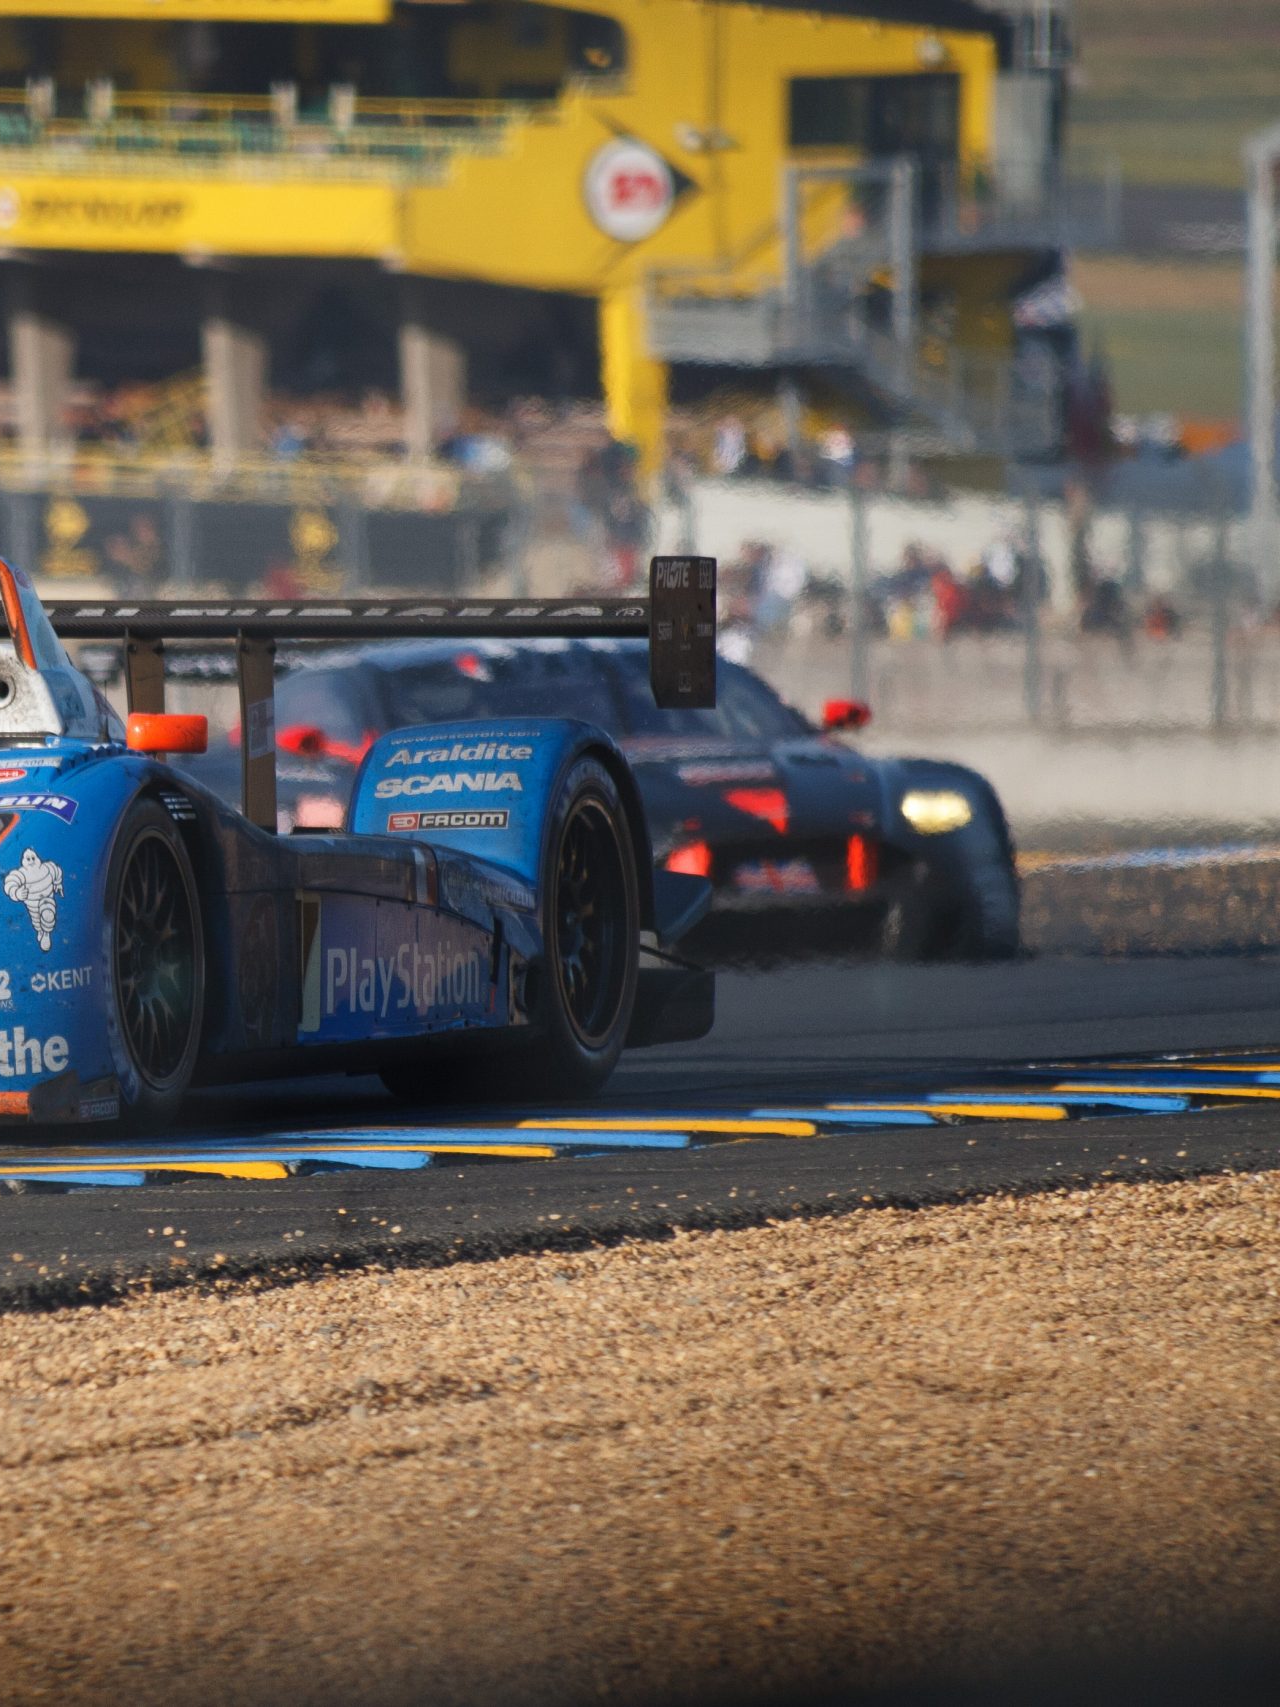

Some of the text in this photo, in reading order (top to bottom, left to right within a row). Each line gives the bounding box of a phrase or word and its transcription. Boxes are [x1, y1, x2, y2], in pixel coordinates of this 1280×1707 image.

[385, 742, 533, 768] Araldite
[374, 773, 523, 799] SCANIA
[422, 813, 504, 827] FACOM
[47, 966, 93, 991] KENT
[326, 941, 480, 1018] PlayStation
